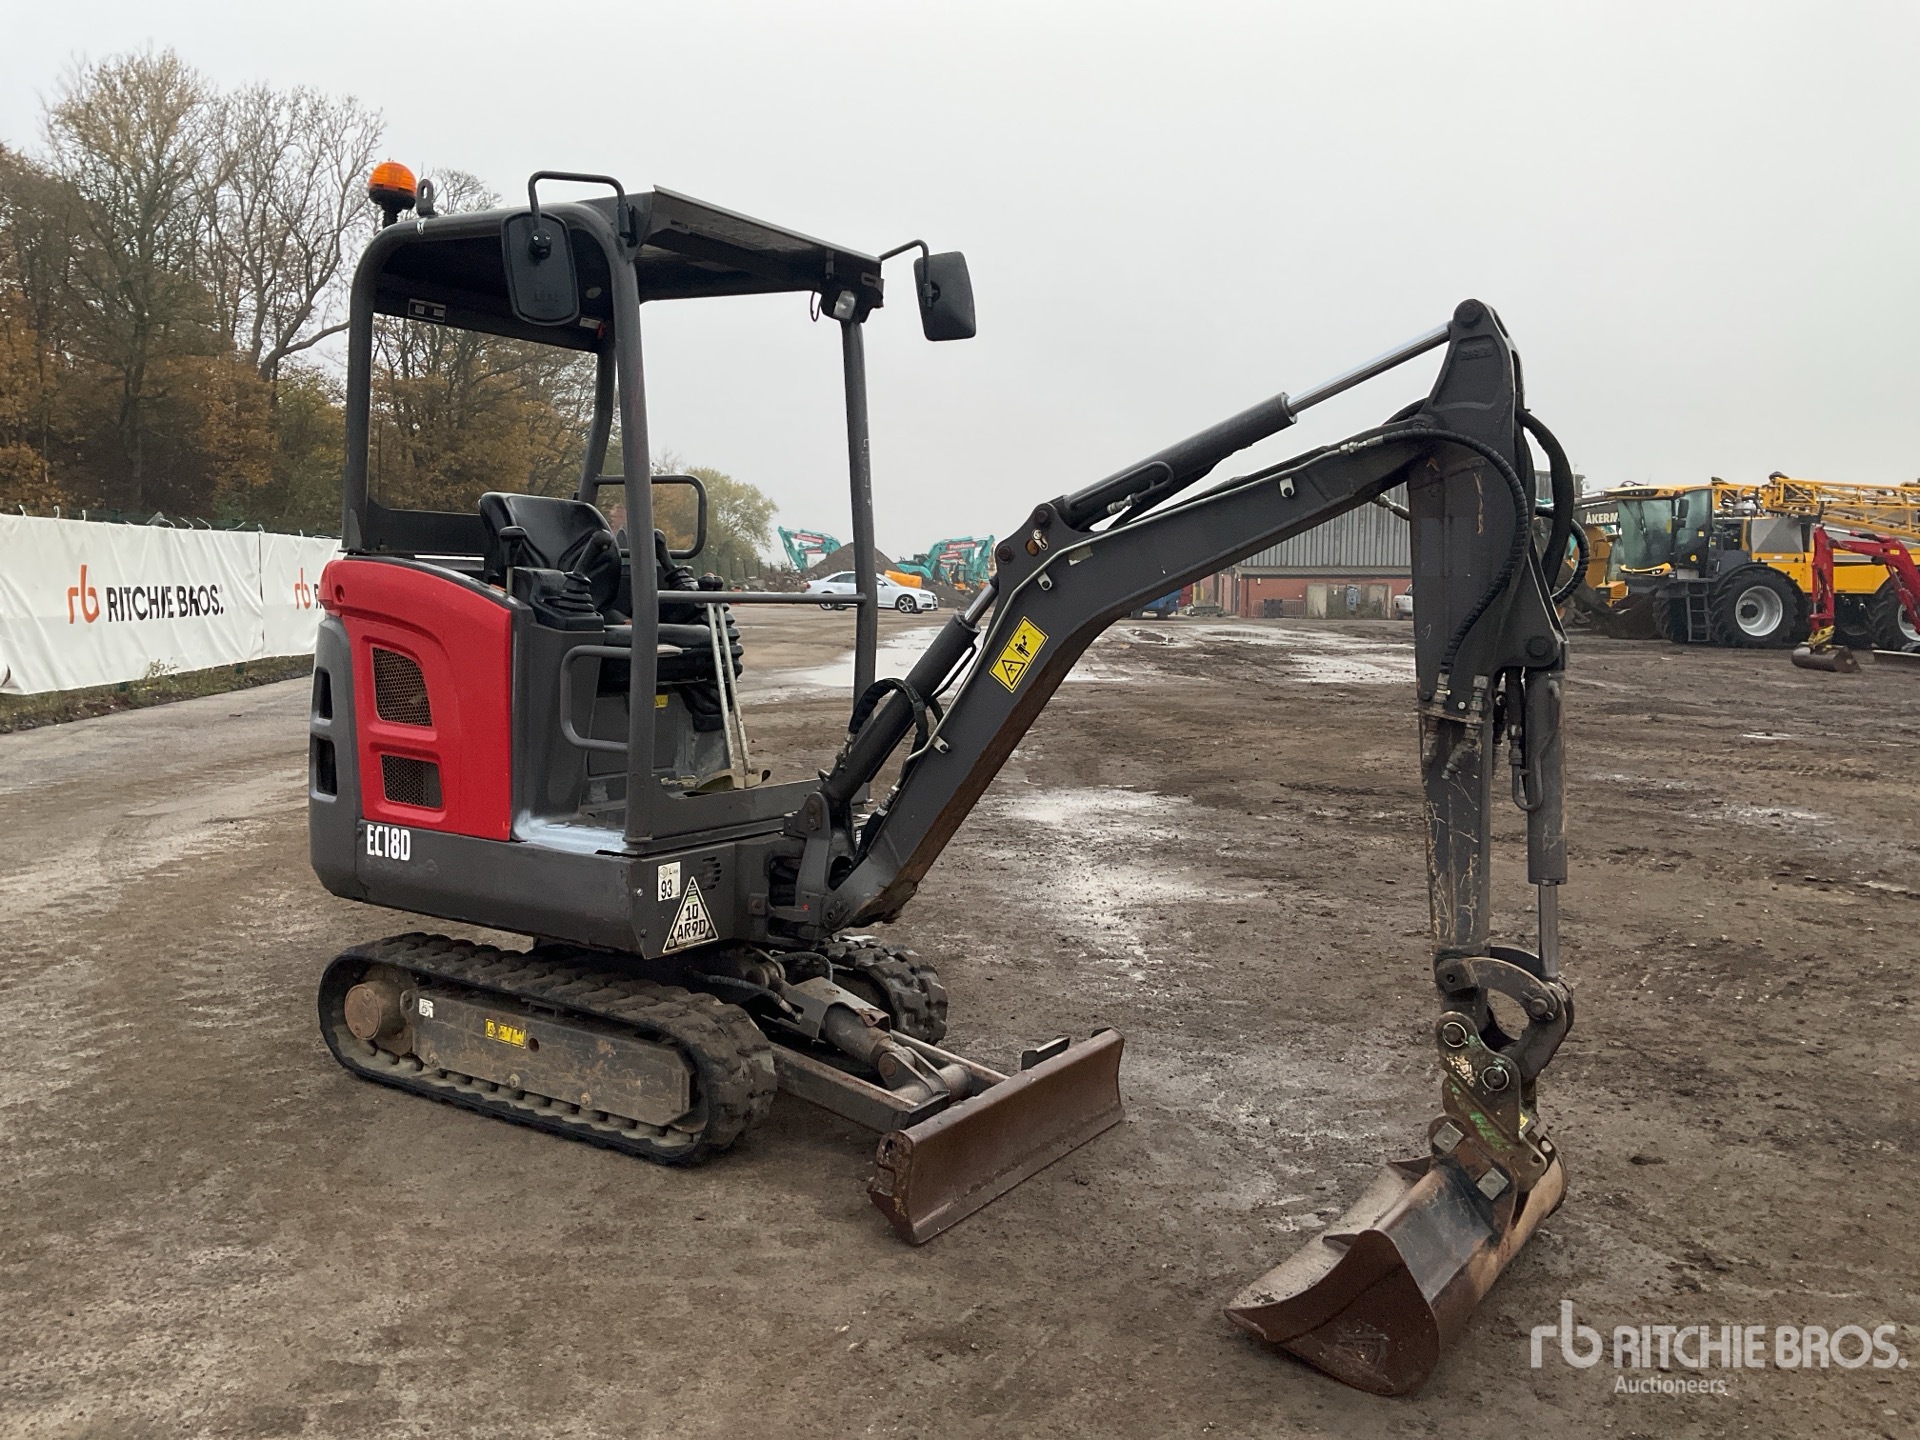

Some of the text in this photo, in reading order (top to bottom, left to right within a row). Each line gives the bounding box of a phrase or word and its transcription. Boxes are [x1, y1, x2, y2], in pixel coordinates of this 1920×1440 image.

[105, 585, 175, 622] RITCHIE
[176, 584, 224, 618] BROS.
[366, 823, 411, 861] EC18D
[661, 879, 673, 899] 93
[677, 919, 706, 940] AR9D
